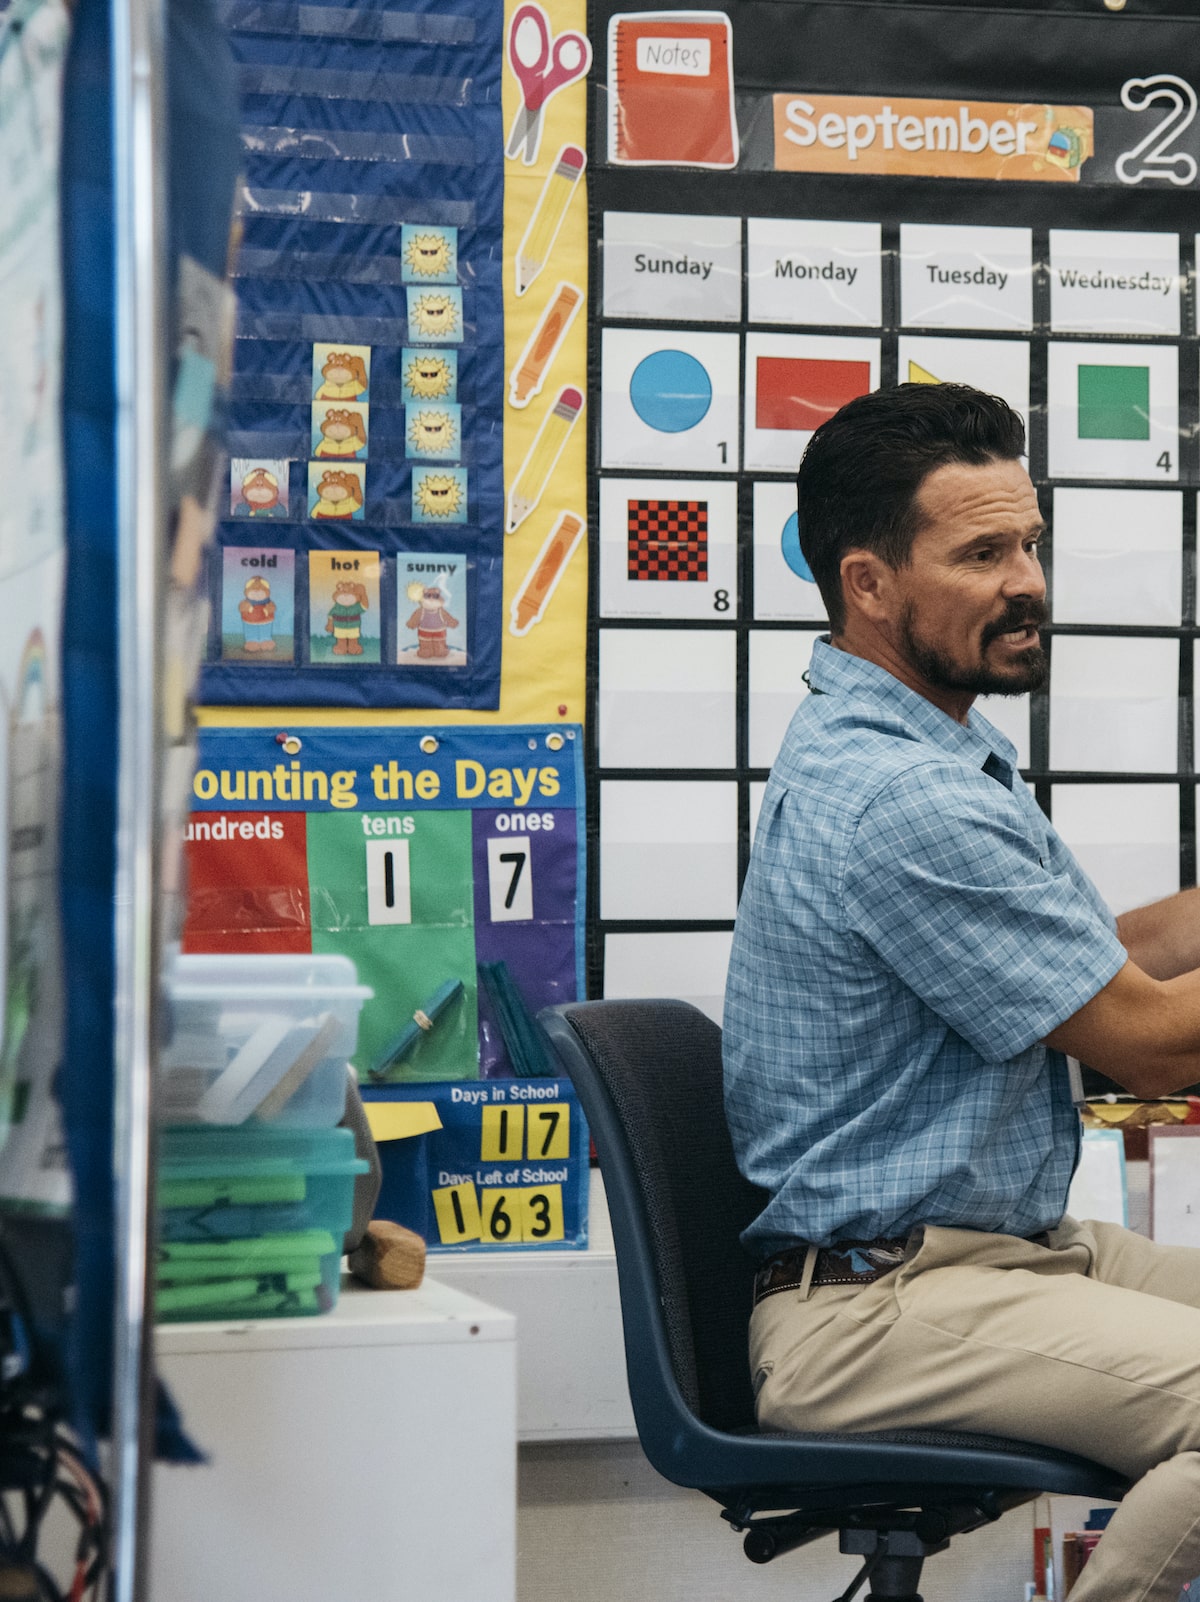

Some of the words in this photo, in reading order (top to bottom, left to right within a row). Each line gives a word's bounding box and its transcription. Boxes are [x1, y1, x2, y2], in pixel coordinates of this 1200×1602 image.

[645, 43, 702, 69] Notes
[784, 100, 1038, 161] September
[633, 254, 714, 279] Sunday
[774, 259, 858, 286] Monday
[926, 265, 1009, 289] Tuesday
[1058, 269, 1173, 295] Wednesday
[717, 442, 729, 465] 1
[1155, 450, 1172, 473] 4
[240, 554, 278, 569] cold
[331, 557, 360, 571] hot
[406, 560, 457, 576] sunny
[713, 589, 730, 612] 8
[193, 760, 358, 808] ounting
[371, 760, 440, 801] the
[455, 759, 561, 806] Days
[183, 815, 284, 841] undreds
[361, 812, 415, 835] tens
[495, 811, 555, 832] ones
[384, 851, 395, 909] 1
[499, 852, 527, 910] 7
[451, 1087, 488, 1105] Days
[492, 1086, 505, 1100] in
[509, 1084, 559, 1100] School
[438, 1171, 474, 1185] Days
[476, 1169, 504, 1185] Left
[506, 1170, 520, 1184] of
[522, 1167, 568, 1184] School
